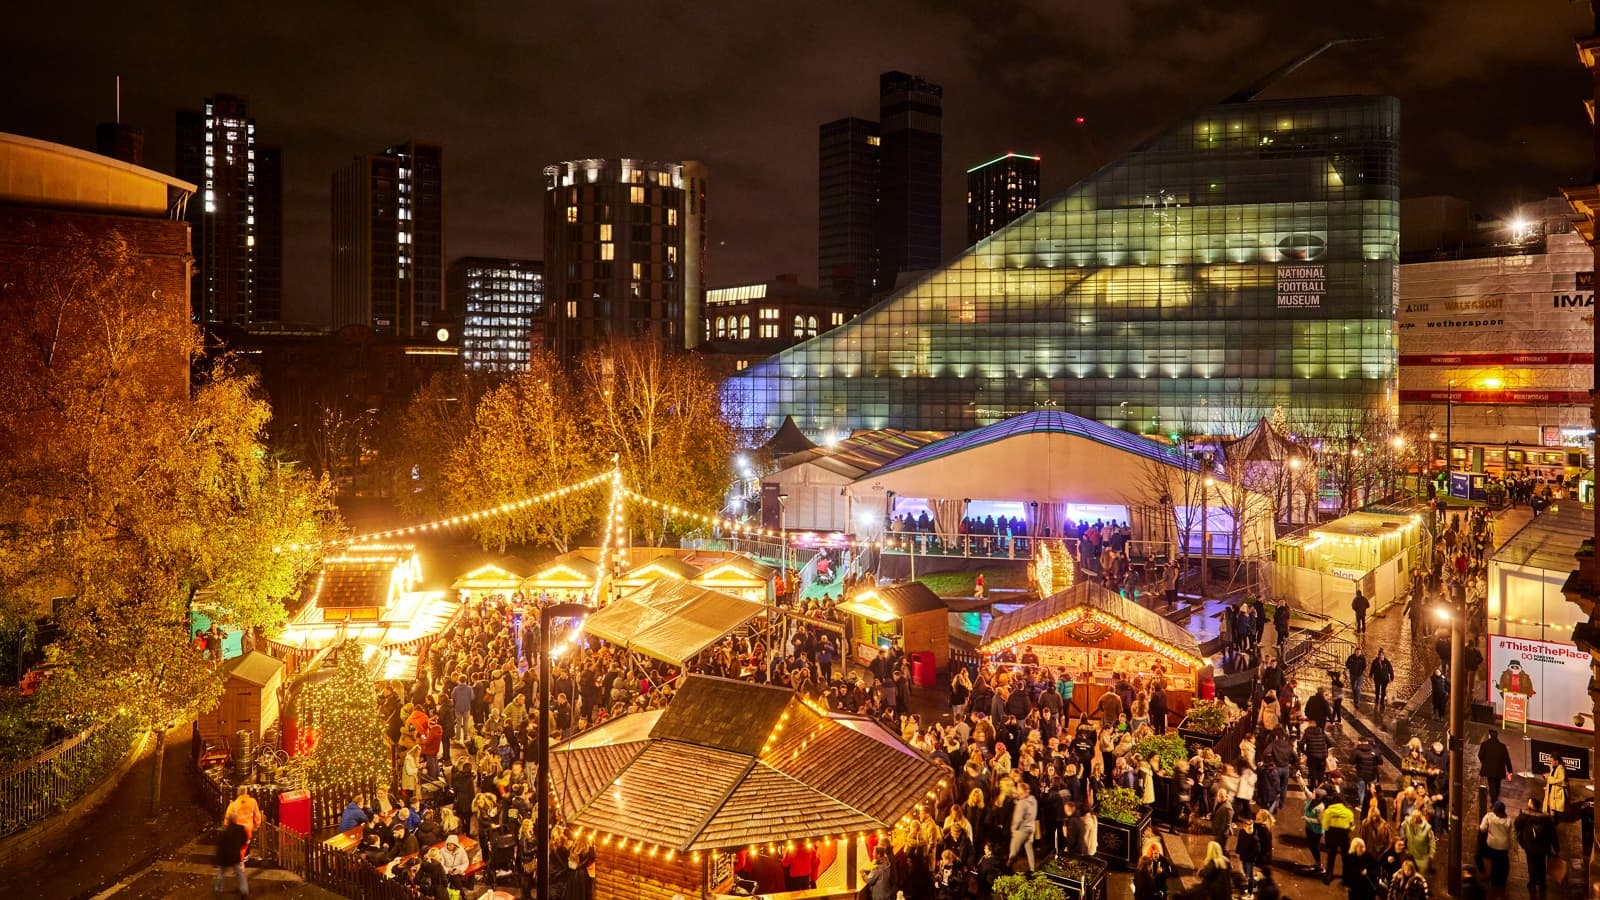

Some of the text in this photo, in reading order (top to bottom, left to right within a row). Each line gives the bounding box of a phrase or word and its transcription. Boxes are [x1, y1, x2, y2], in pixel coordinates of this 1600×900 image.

[1277, 268, 1325, 279] NATIONAL
[1277, 281, 1325, 292] FOOTBALL
[1277, 294, 1320, 305] MUSEUM
[1444, 299, 1504, 311] WALKABOUT
[1554, 295, 1594, 308] IMA
[1427, 319, 1504, 328] wetherspoon
[990, 641, 1016, 654] DUTCH
[1017, 631, 1038, 643] MINI
[1039, 614, 1079, 635] PANCAKES
[1095, 614, 1123, 633] DUTCH
[1124, 628, 1153, 647] SUGAR
[1153, 644, 1191, 667] WAFFLES
[1499, 640, 1589, 660] #ThisIsThePlace
